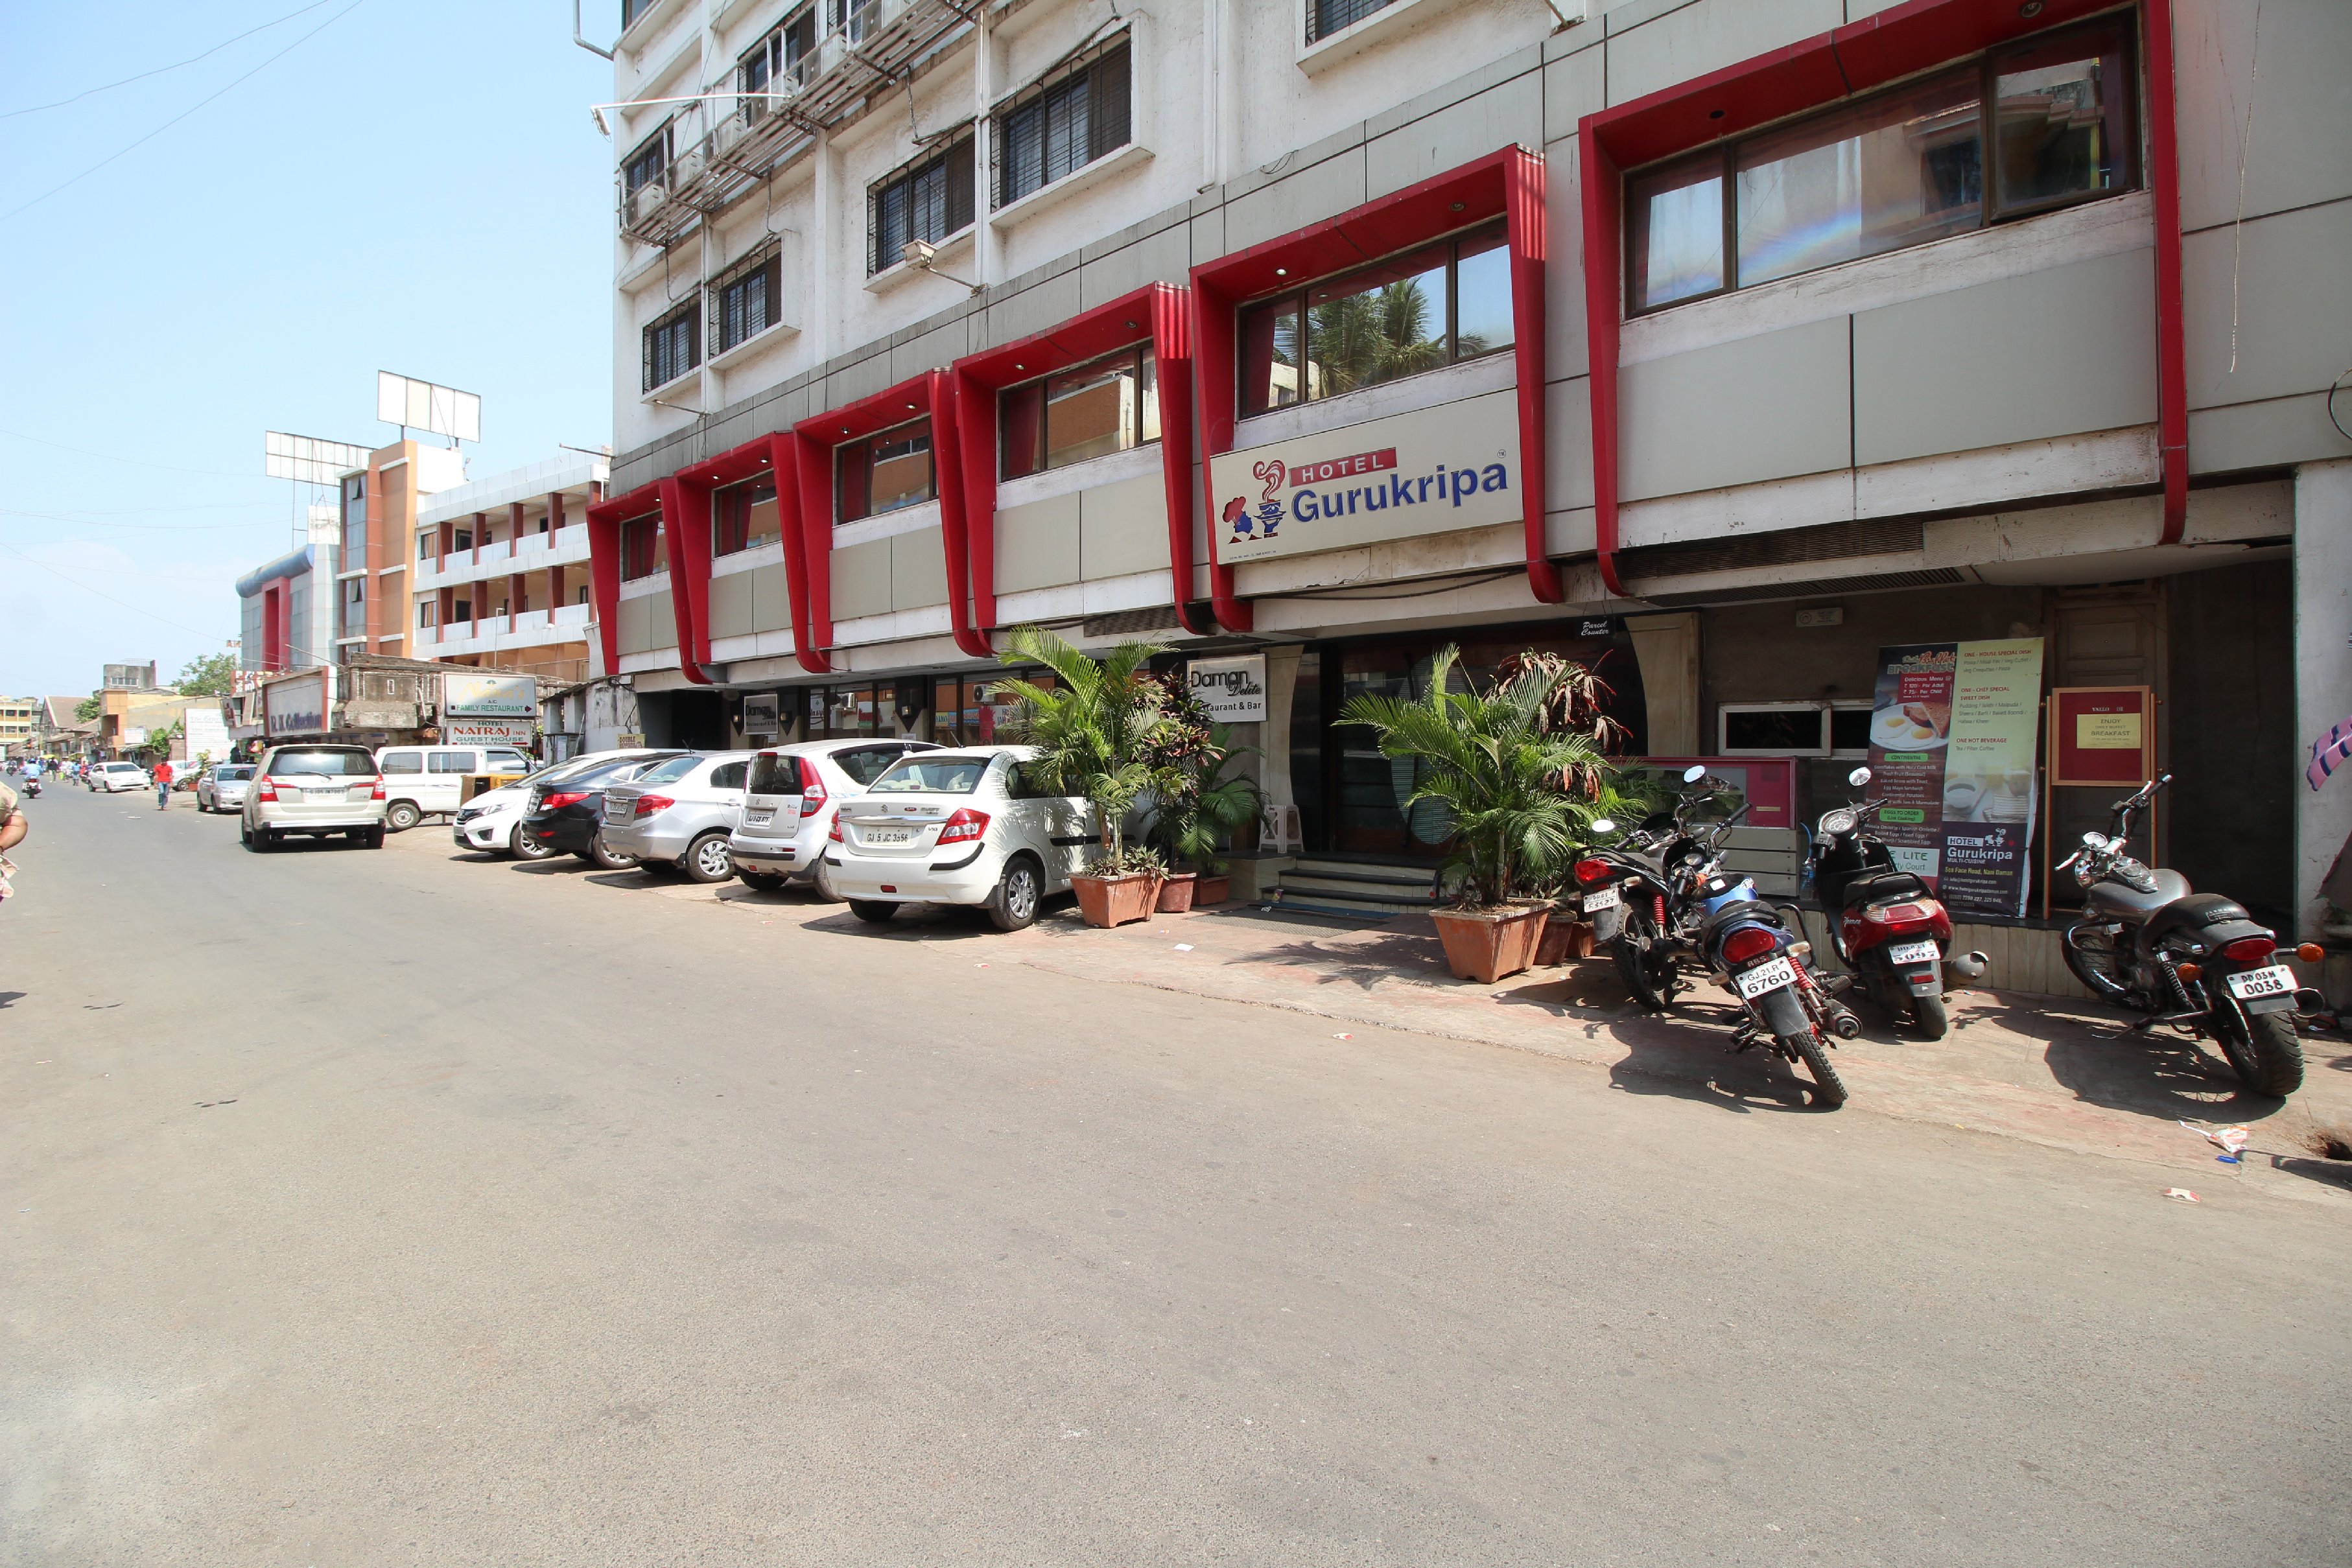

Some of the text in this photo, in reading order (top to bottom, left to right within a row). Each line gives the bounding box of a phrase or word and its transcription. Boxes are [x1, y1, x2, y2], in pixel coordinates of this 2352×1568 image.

[1302, 454, 1384, 482] HOTEL
[1290, 462, 1509, 524] Gurukripa
[1582, 620, 1608, 629] Parcel
[1190, 670, 1249, 688] Daman
[1226, 682, 1262, 697] Delite
[1239, 701, 1245, 710] &
[454, 727, 510, 737] NATRAJ
[867, 833, 875, 841] GJ
[876, 833, 881, 841] 5
[883, 833, 891, 841] JC
[1949, 837, 1978, 846] HOTEL
[1903, 851, 1929, 861] LITE
[1947, 847, 2013, 862] Gurukripa
[1905, 862, 1926, 871] Court
[1747, 955, 1767, 967] RBS
[1748, 965, 1780, 981] GJ.21.R
[1747, 970, 1791, 993] 6760
[2244, 979, 2283, 995] 0038
